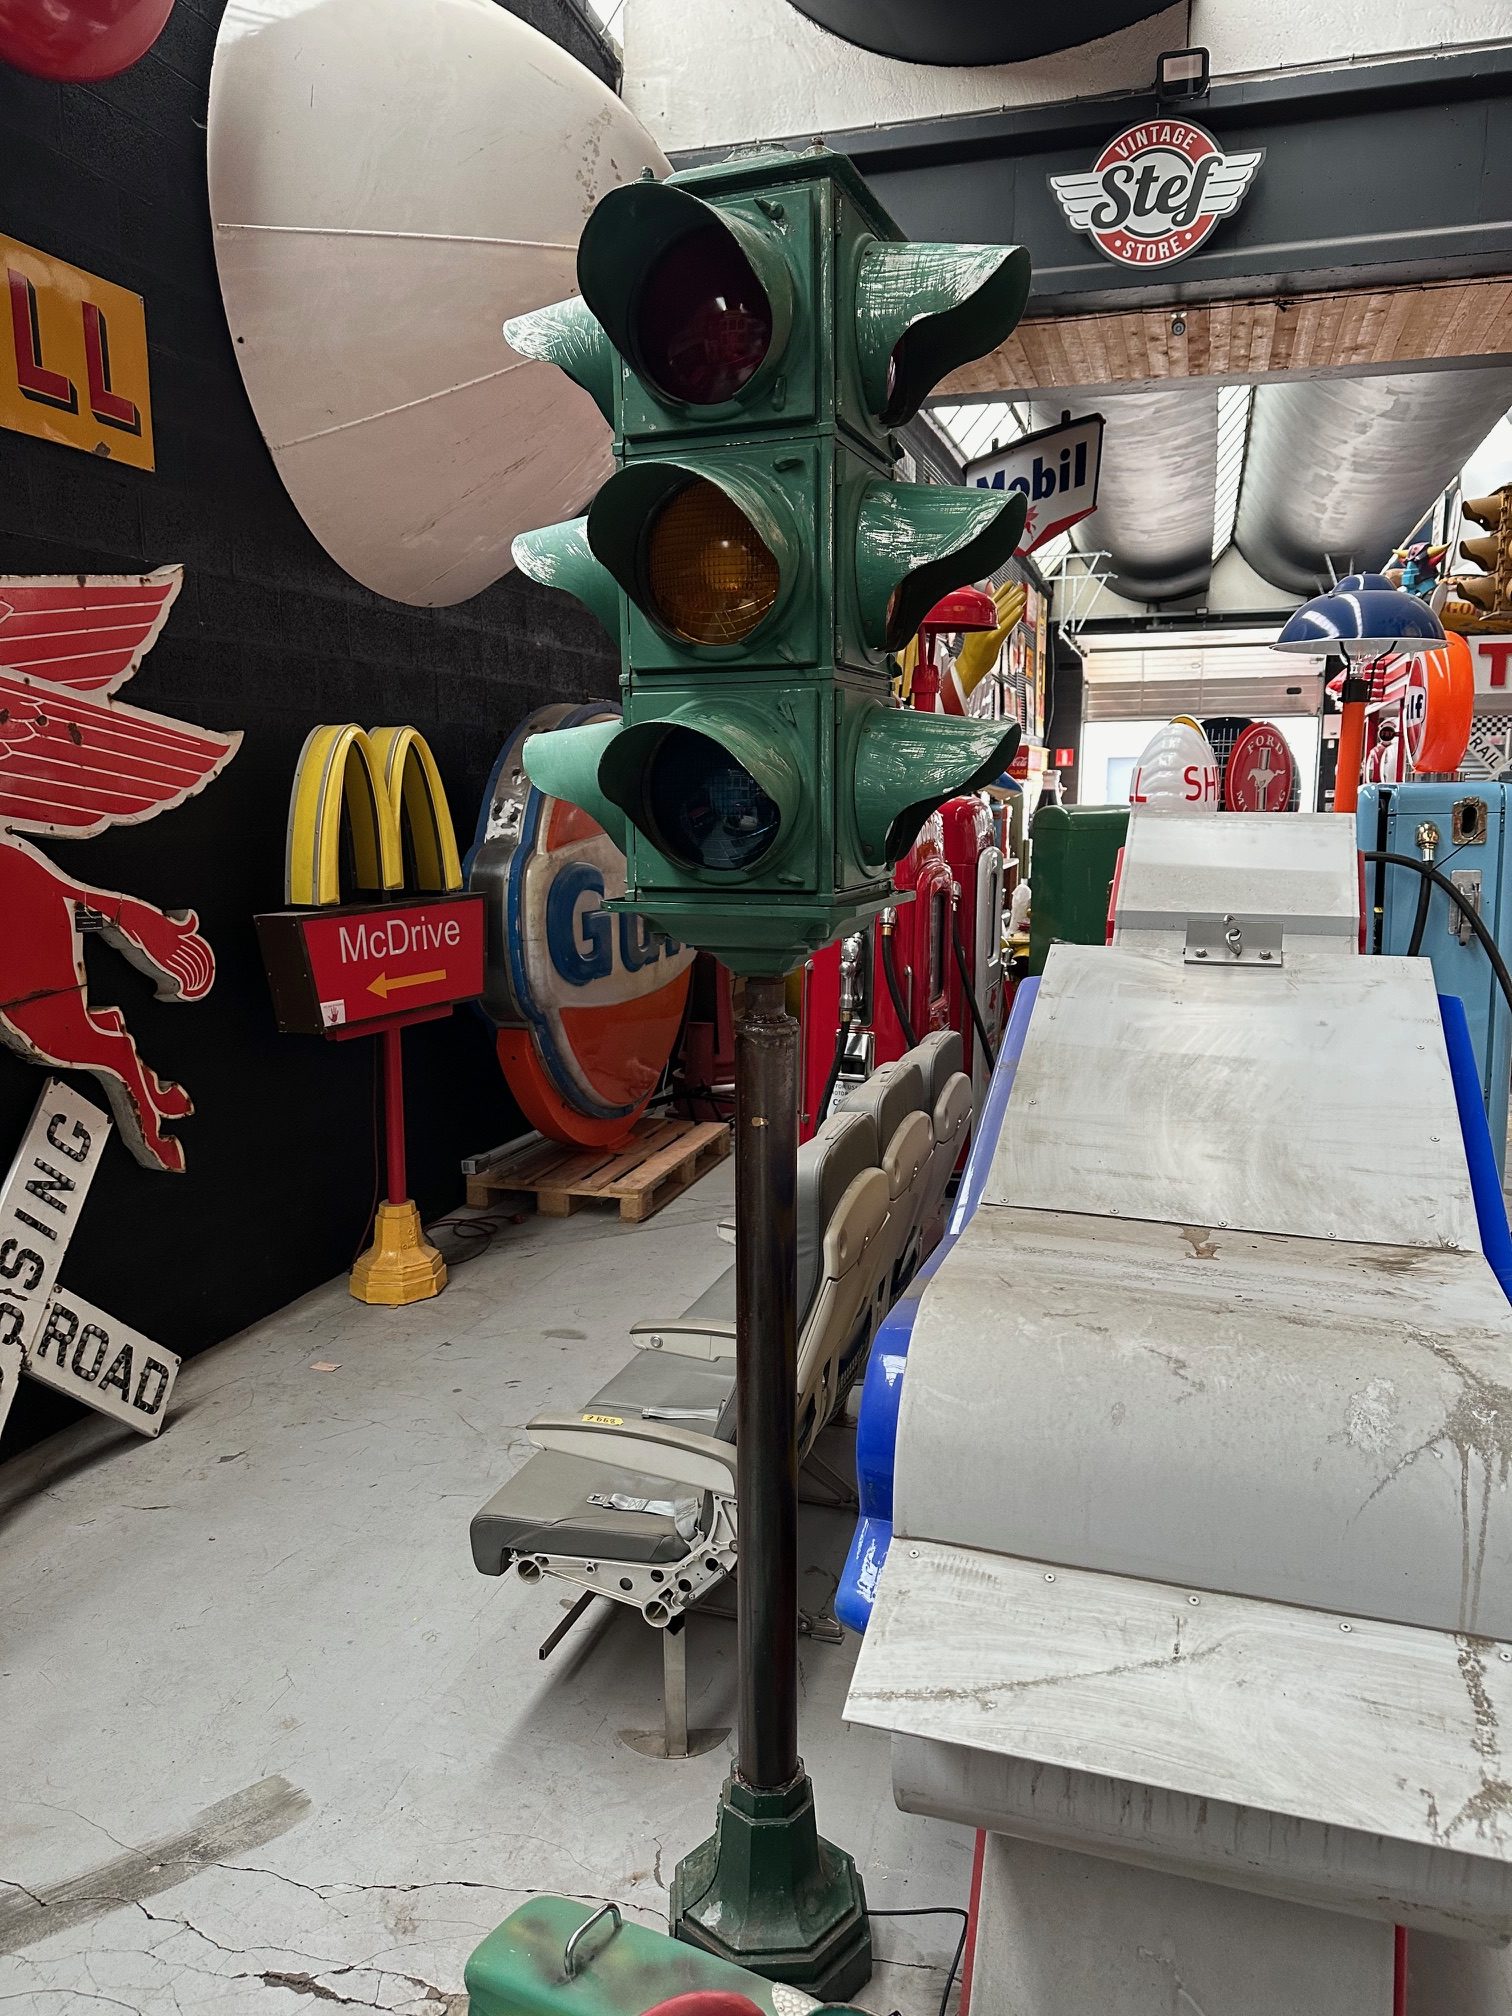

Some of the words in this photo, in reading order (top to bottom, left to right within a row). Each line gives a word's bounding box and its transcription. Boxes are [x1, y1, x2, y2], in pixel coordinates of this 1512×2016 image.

[1115, 125, 1198, 158] VINTAGE
[1091, 156, 1224, 229] Stef
[1122, 235, 1183, 261] STORE
[1247, 735, 1284, 755] FORD
[1469, 736, 1499, 770] RAIL
[338, 916, 461, 964] McDrive
[546, 862, 696, 987] Gu
[37, 1302, 169, 1415] ROAD
